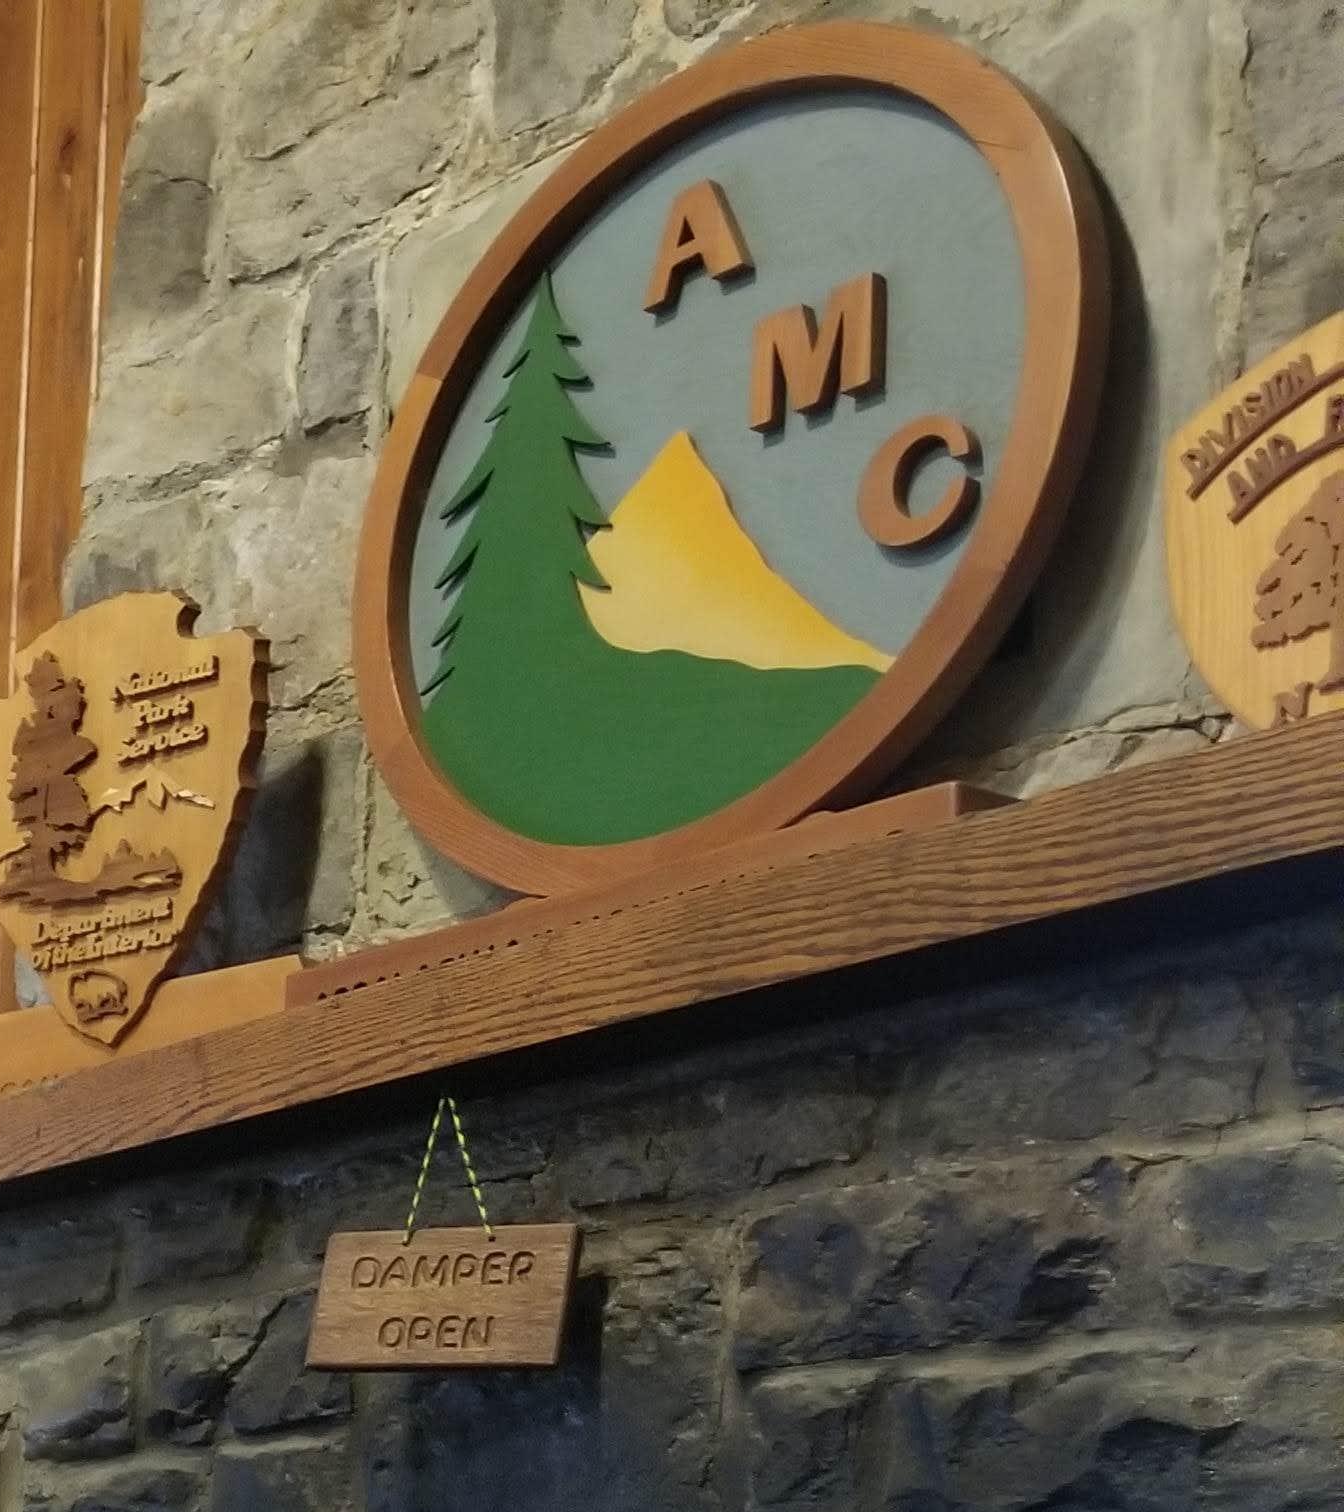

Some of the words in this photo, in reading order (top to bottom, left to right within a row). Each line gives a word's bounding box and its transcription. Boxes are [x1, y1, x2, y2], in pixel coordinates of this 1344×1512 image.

[1181, 353, 1316, 488] DIVISION
[1227, 433, 1298, 510] AND
[111, 655, 220, 704] National
[132, 694, 195, 729] Park
[115, 724, 209, 768] Service
[31, 897, 174, 947] Department
[32, 945, 54, 971] of
[53, 941, 88, 966] the
[85, 928, 182, 961] Interior
[351, 1250, 537, 1289] DAMPER
[378, 1314, 496, 1350] OPEN
